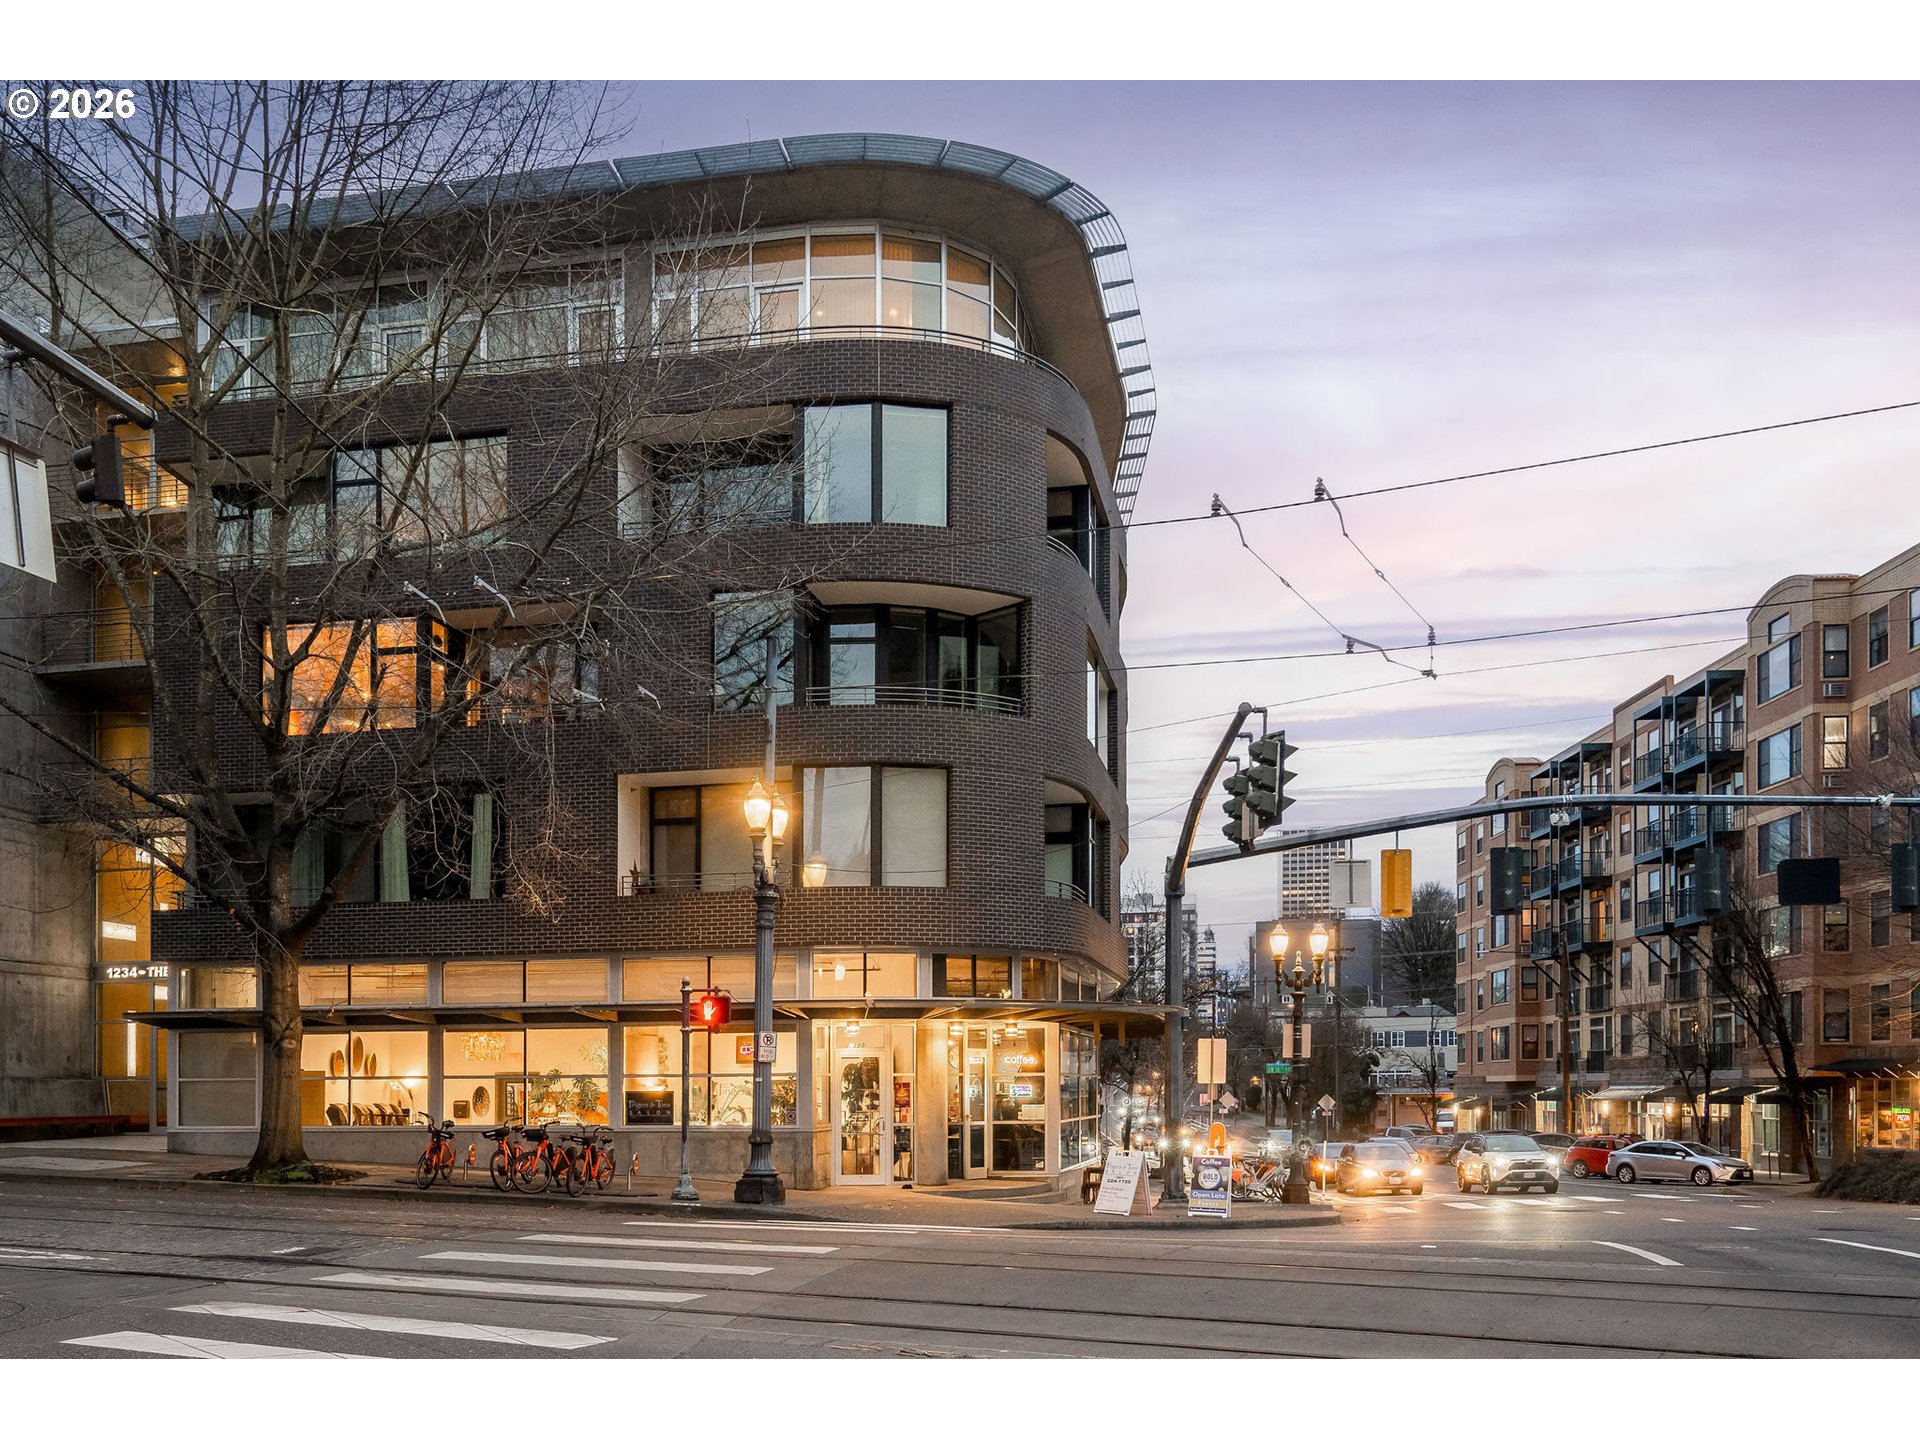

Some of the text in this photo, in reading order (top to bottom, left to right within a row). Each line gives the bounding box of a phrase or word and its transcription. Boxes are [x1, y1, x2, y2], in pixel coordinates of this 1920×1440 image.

[106, 967, 138, 979] 1234
[1201, 1158, 1222, 1166] Coffee
[1202, 1173, 1219, 1181] BOLD
[1192, 1191, 1226, 1200] Open Late
[1198, 1200, 1219, 1208] Events
